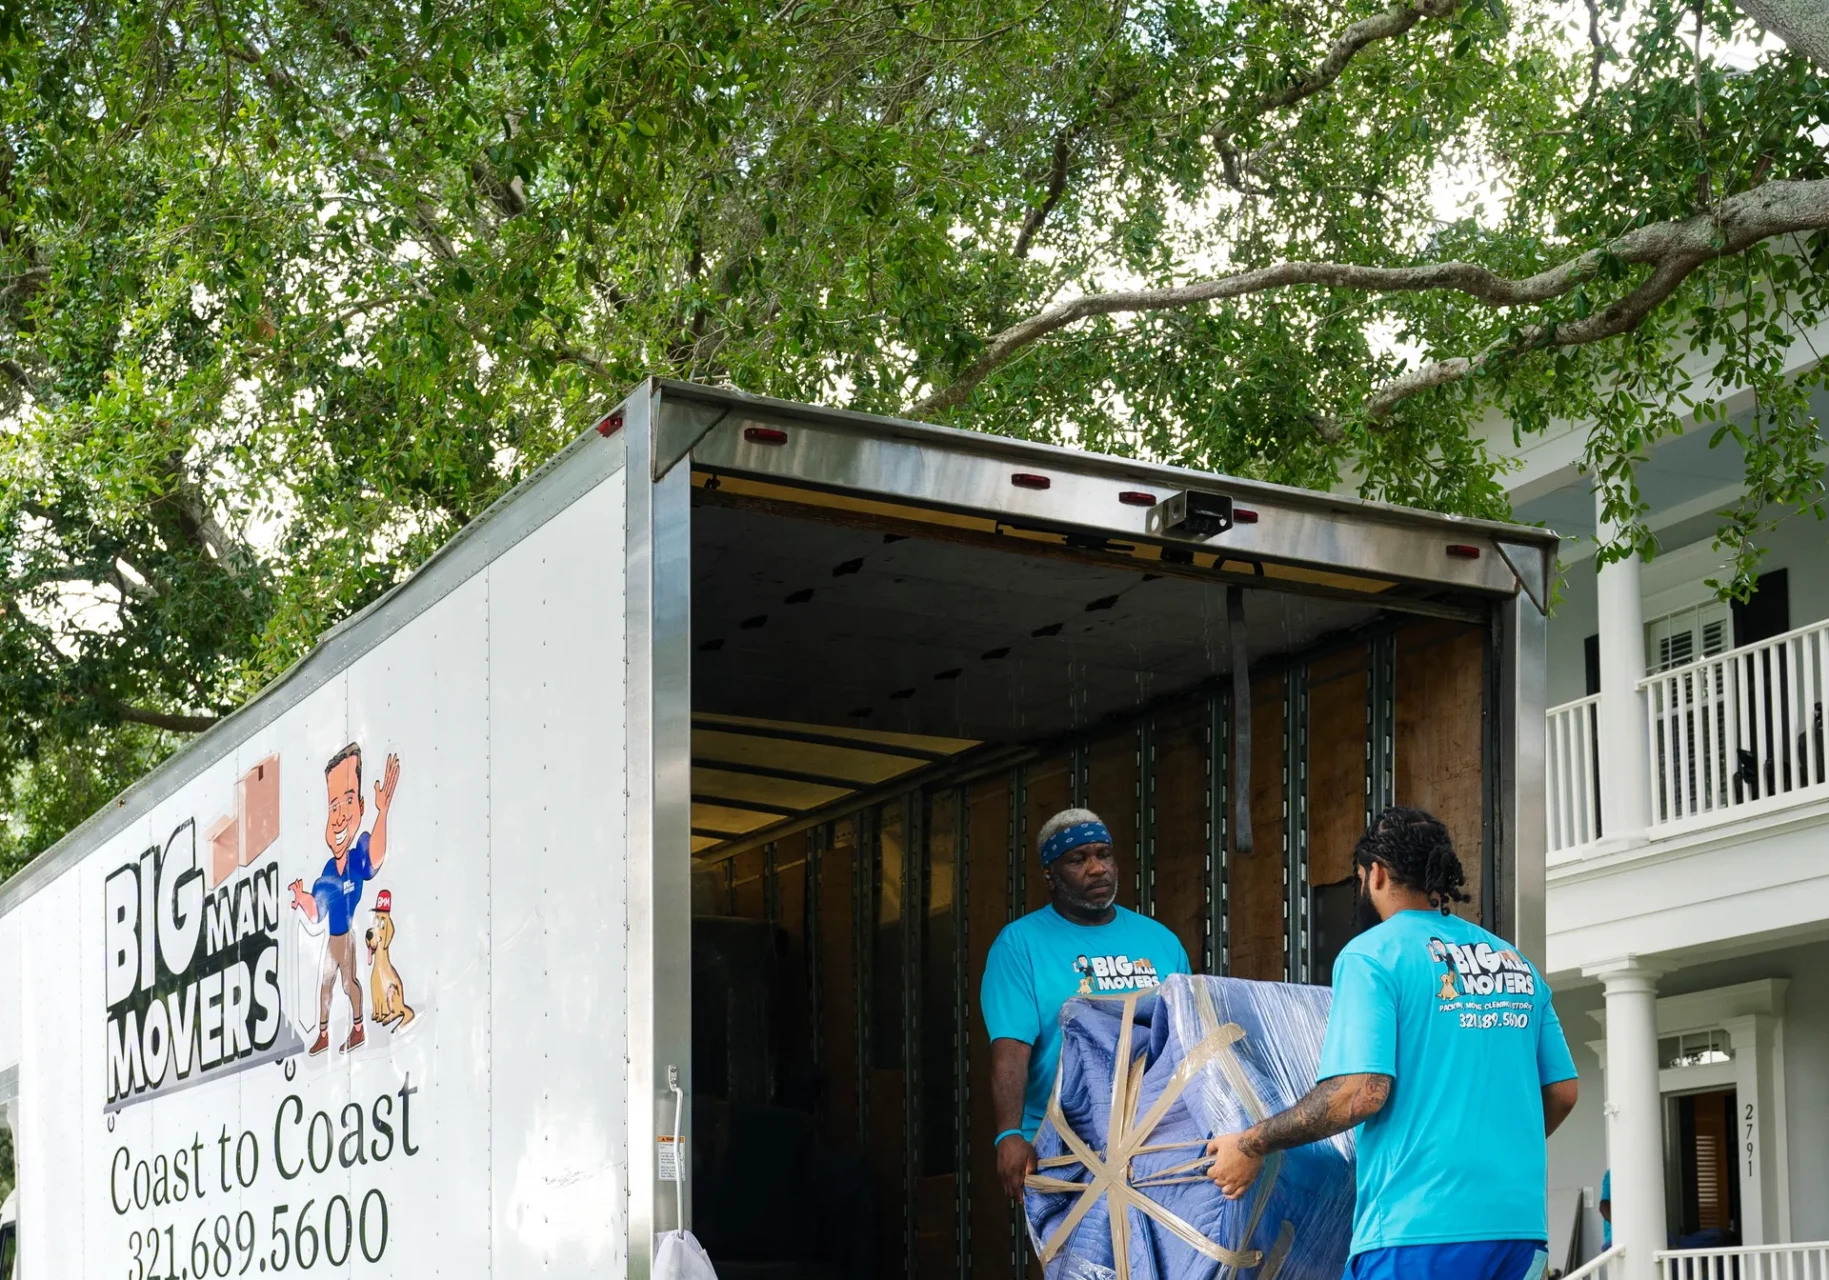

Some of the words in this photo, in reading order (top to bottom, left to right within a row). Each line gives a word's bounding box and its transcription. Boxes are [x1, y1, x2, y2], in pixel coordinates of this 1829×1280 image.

[104, 816, 205, 1009] BIG
[204, 861, 279, 957] MAN
[1090, 954, 1135, 977] BIG
[1134, 965, 1157, 975] MAN
[1096, 975, 1161, 991] MOVERS
[1446, 942, 1501, 975] BIG
[1460, 971, 1535, 996] MOVERS
[105, 939, 282, 1104] MOVERS
[110, 1131, 206, 1216] Coast
[217, 1122, 260, 1194] to
[274, 1070, 420, 1181] Coast
[1745, 1103, 1753, 1177] 2791
